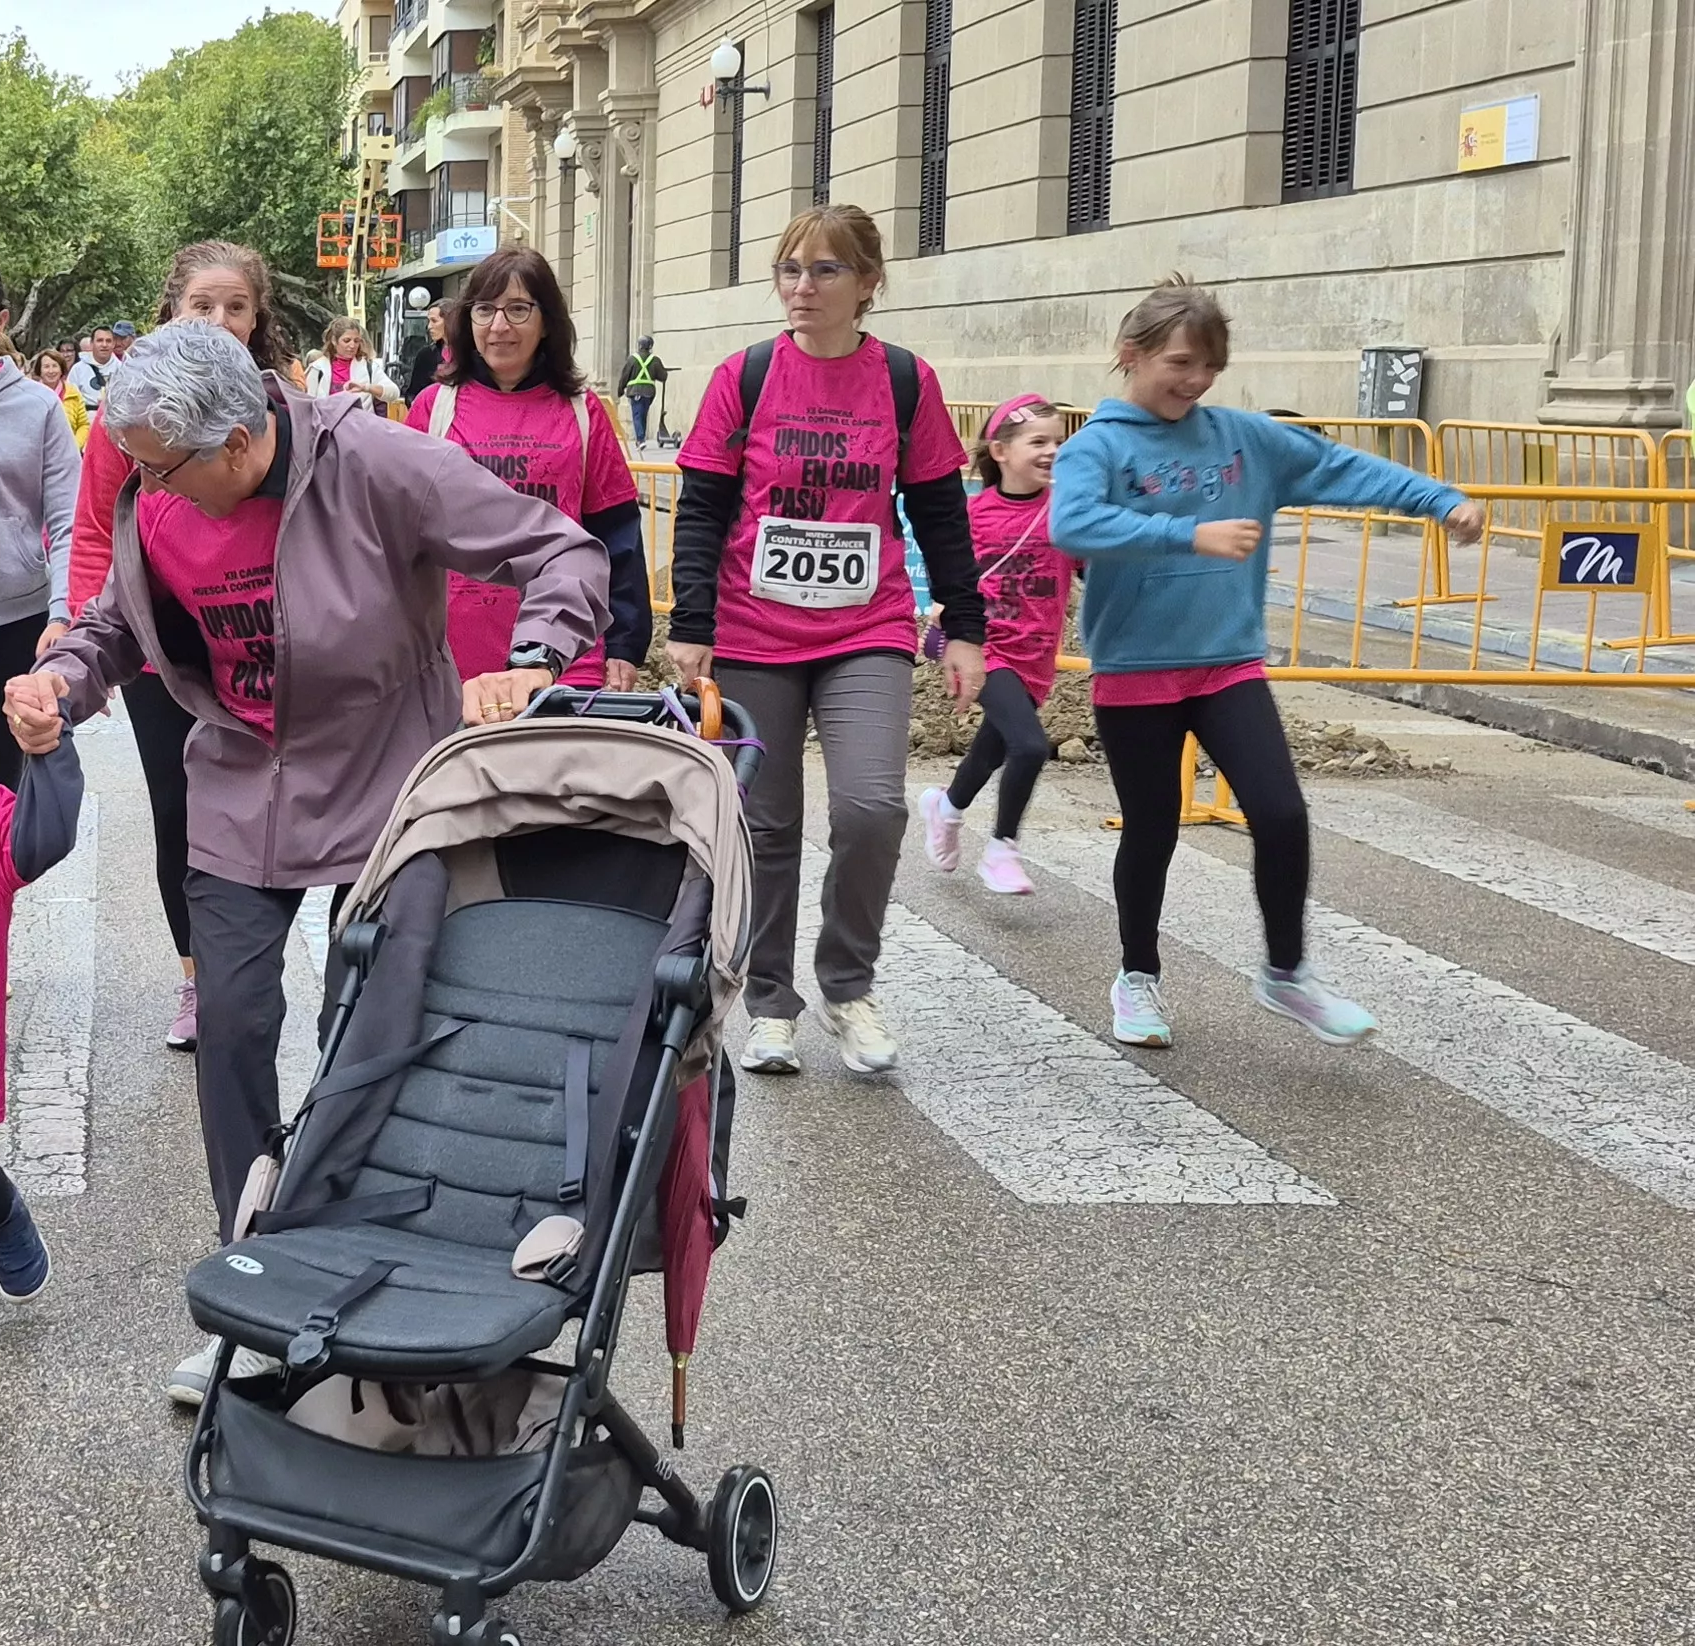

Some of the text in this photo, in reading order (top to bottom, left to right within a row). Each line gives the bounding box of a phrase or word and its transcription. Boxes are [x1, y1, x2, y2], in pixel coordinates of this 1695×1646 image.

[808, 415, 839, 425] CONTRA
[773, 428, 847, 459] UNIDOS
[802, 459, 881, 493] EN CADA
[769, 487, 827, 521] PASO
[771, 534, 865, 548] CONTRA EL CÁNCER
[765, 548, 865, 585] 2050
[229, 577, 272, 592] CONTRA
